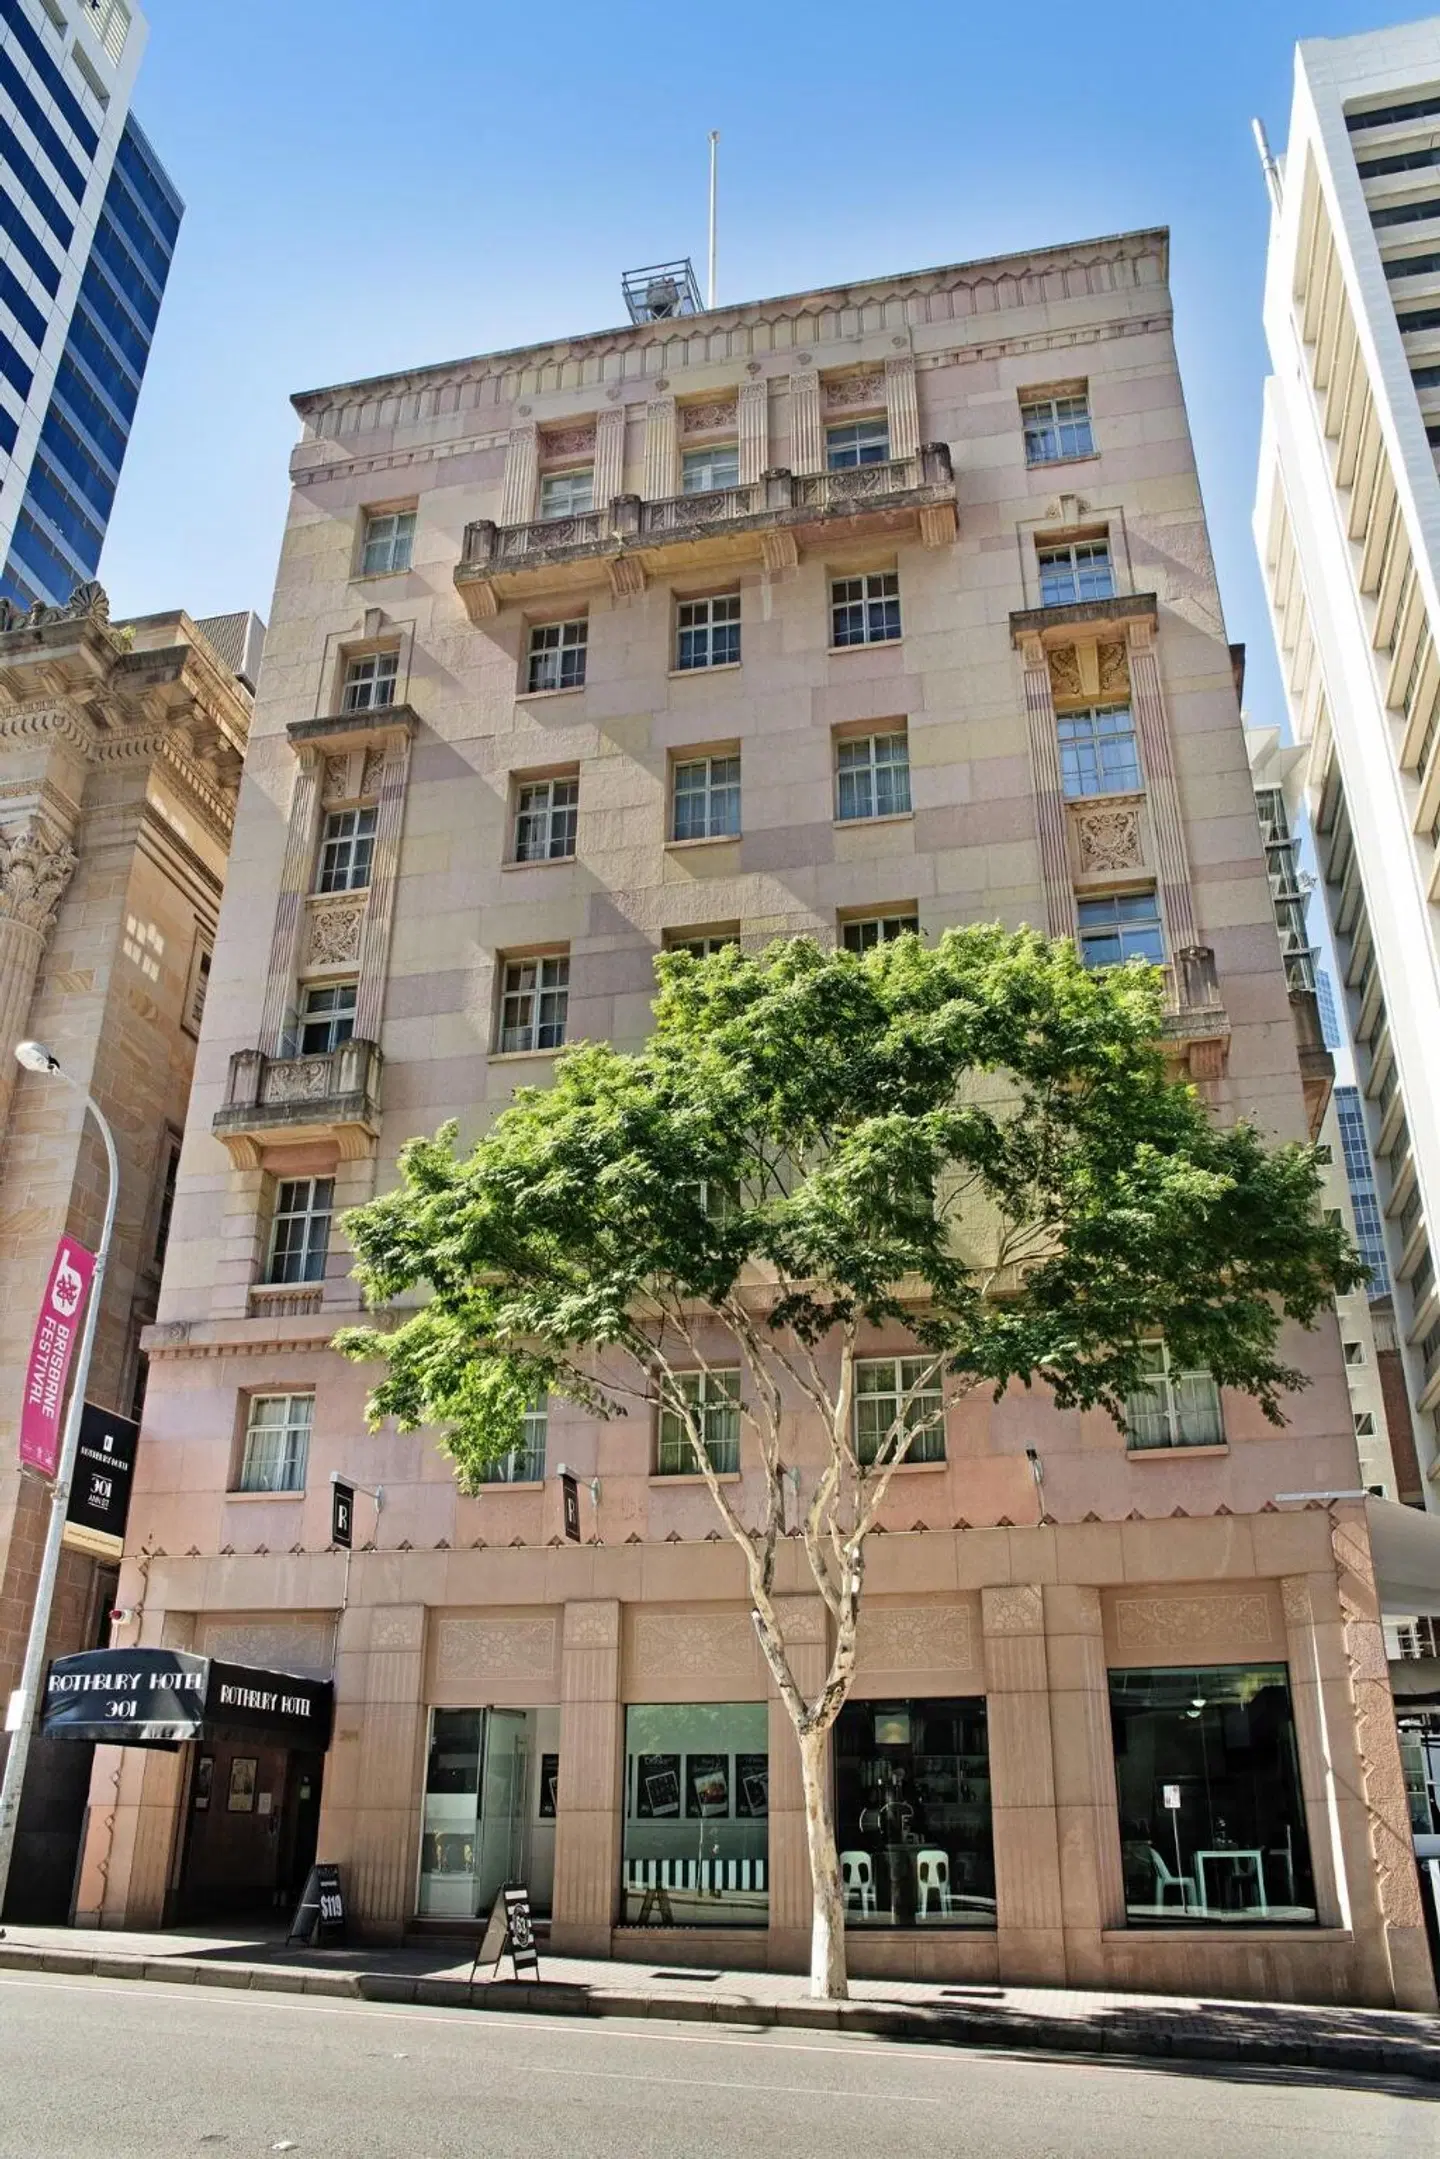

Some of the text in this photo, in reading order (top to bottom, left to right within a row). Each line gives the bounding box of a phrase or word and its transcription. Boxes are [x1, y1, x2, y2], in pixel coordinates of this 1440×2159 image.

[29, 1316, 57, 1405] FESTIVAL
[42, 1323, 70, 1419] BRISBANE
[338, 1505, 348, 1530] R
[48, 1673, 204, 1692] ROTHBURY HOTEL
[105, 1700, 137, 1717] 301
[220, 1684, 311, 1717] ROTHBURY HOTEL
[320, 1894, 343, 1920] $119
